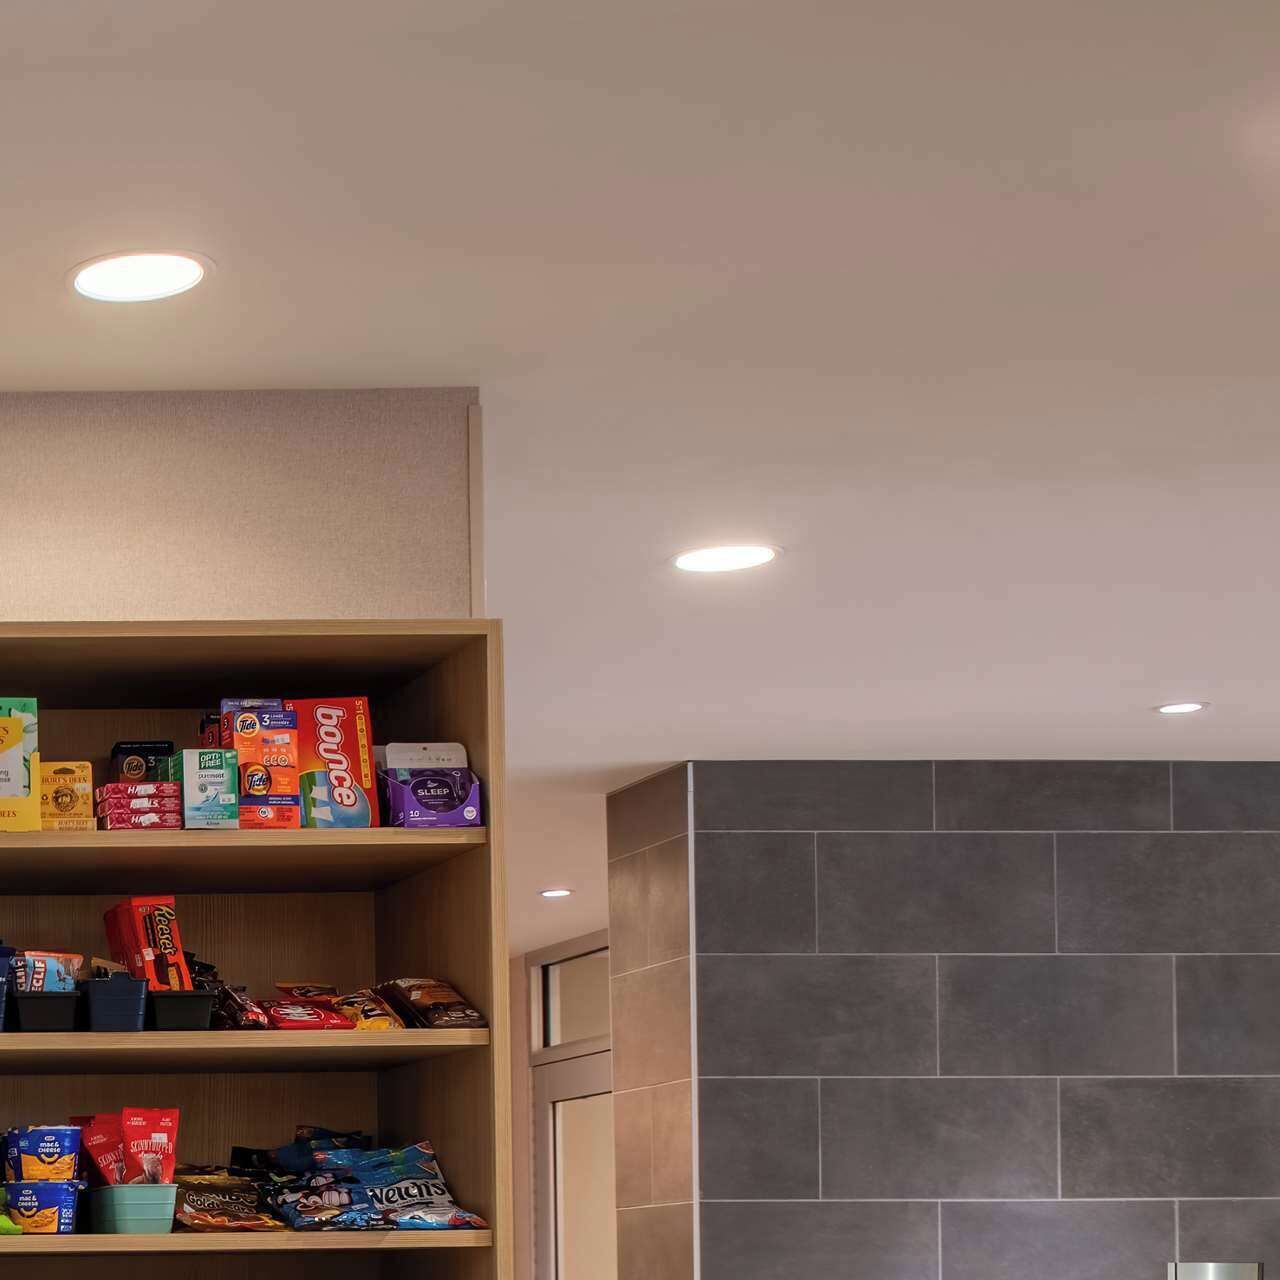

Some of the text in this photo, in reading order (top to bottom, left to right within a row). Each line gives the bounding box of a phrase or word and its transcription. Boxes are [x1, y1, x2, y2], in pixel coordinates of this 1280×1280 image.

[239, 720, 257, 733] Tide
[262, 714, 270, 725] 3
[200, 759, 221, 769] FREE
[315, 705, 355, 807] bounce
[247, 773, 267, 791] Tide
[417, 788, 450, 796] SLEEP
[154, 904, 178, 956] Reese's
[32, 960, 46, 987] CLIF
[368, 1180, 446, 1209] Welch's
